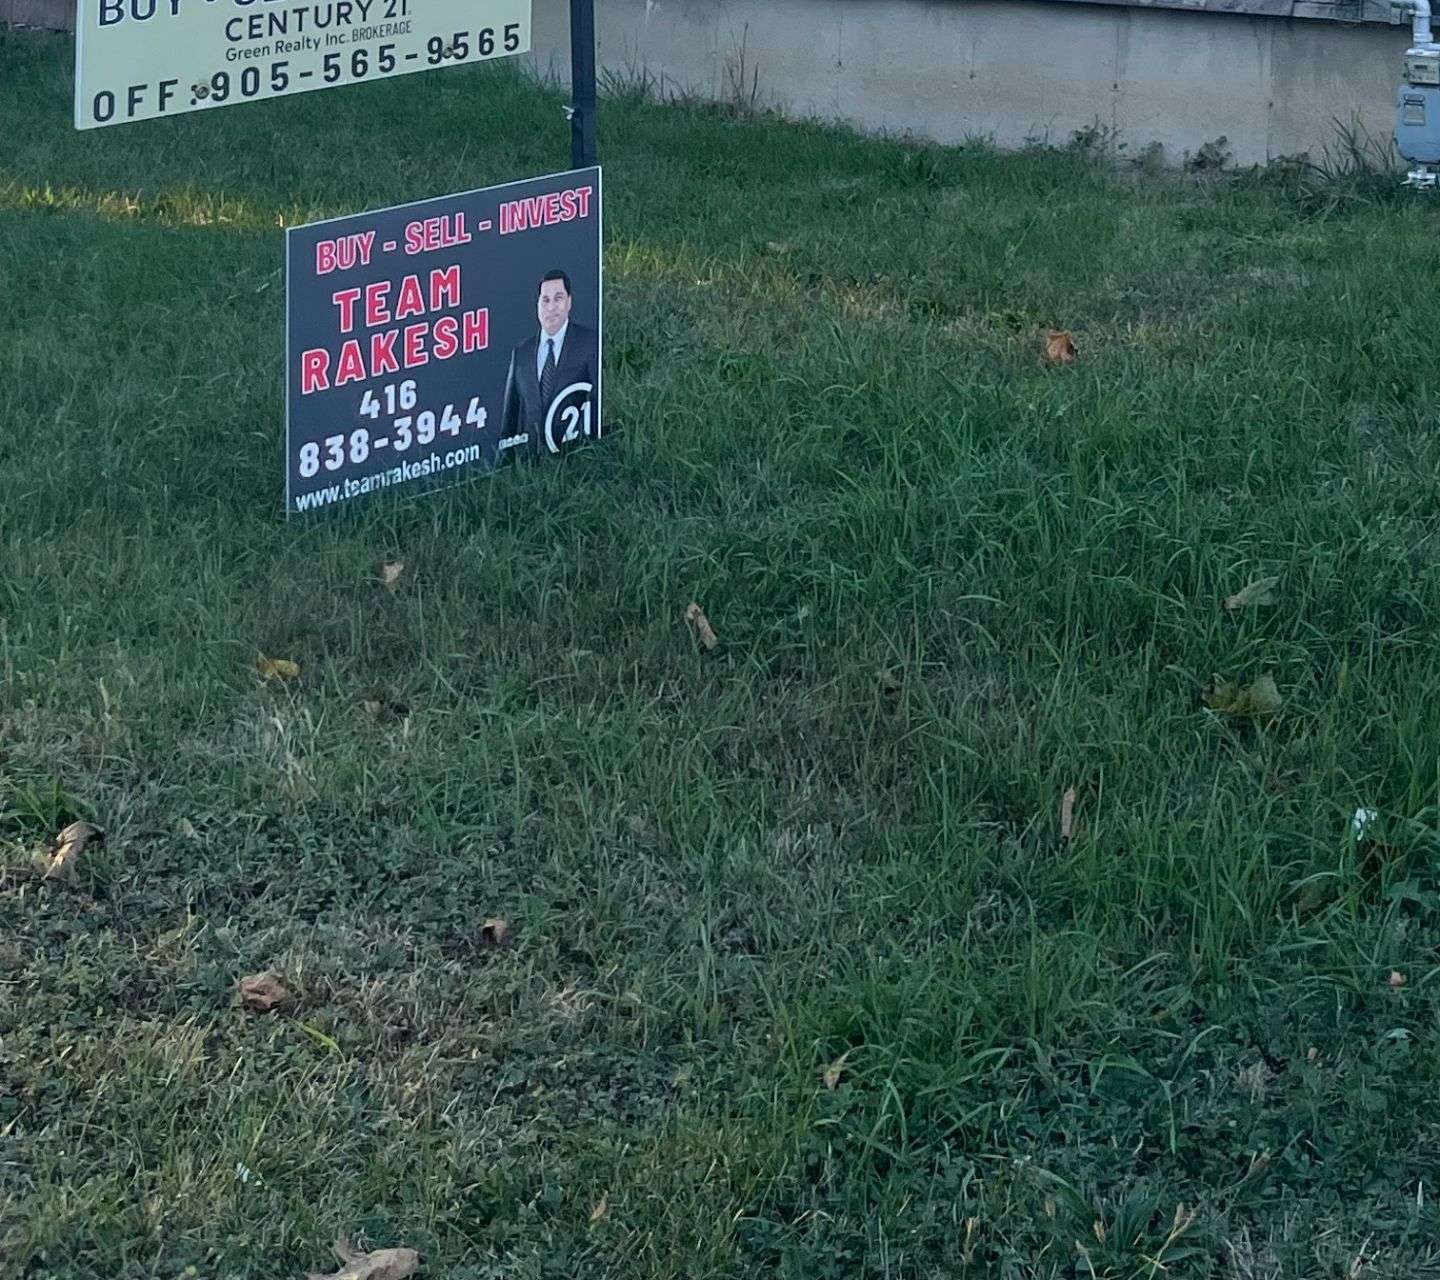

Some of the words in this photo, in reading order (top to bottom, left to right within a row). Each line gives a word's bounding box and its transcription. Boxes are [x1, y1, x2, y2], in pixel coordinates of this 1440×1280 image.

[225, 45, 270, 61] Green
[274, 34, 320, 53] Realty
[352, 20, 412, 42] BROKERAGE
[316, 231, 376, 275] BUY
[405, 213, 471, 255] SELL
[500, 187, 592, 234] INVEST
[333, 265, 460, 333] TEAM
[301, 308, 489, 394] RAKESH
[359, 379, 418, 419] 416
[299, 396, 488, 478] 838-3944
[295, 443, 480, 513] www.teamrakesh.com
